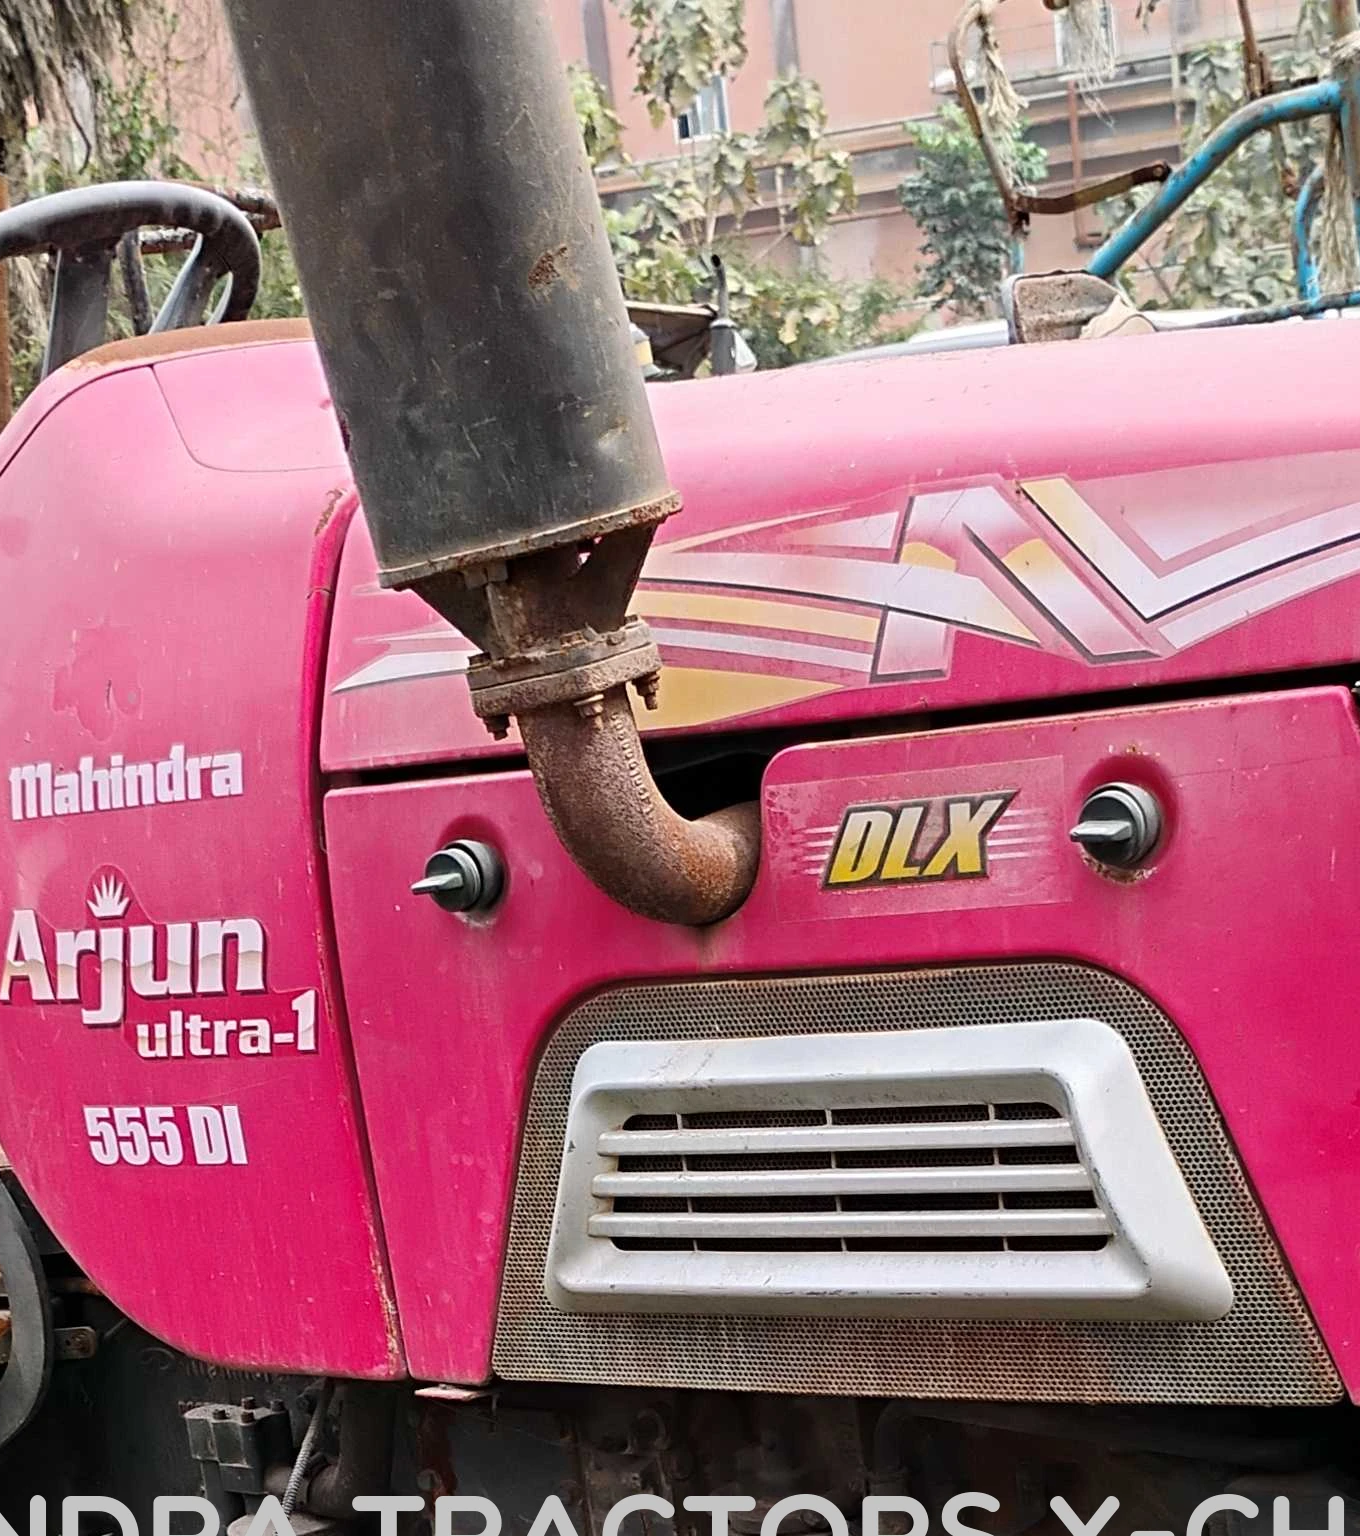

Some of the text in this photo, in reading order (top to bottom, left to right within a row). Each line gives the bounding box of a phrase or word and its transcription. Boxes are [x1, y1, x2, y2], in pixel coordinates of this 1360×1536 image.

[10, 744, 244, 820] Mahindra
[827, 799, 1005, 884] DLX
[136, 990, 317, 1058] ultra-1
[83, 1104, 249, 1166] 555 DI
